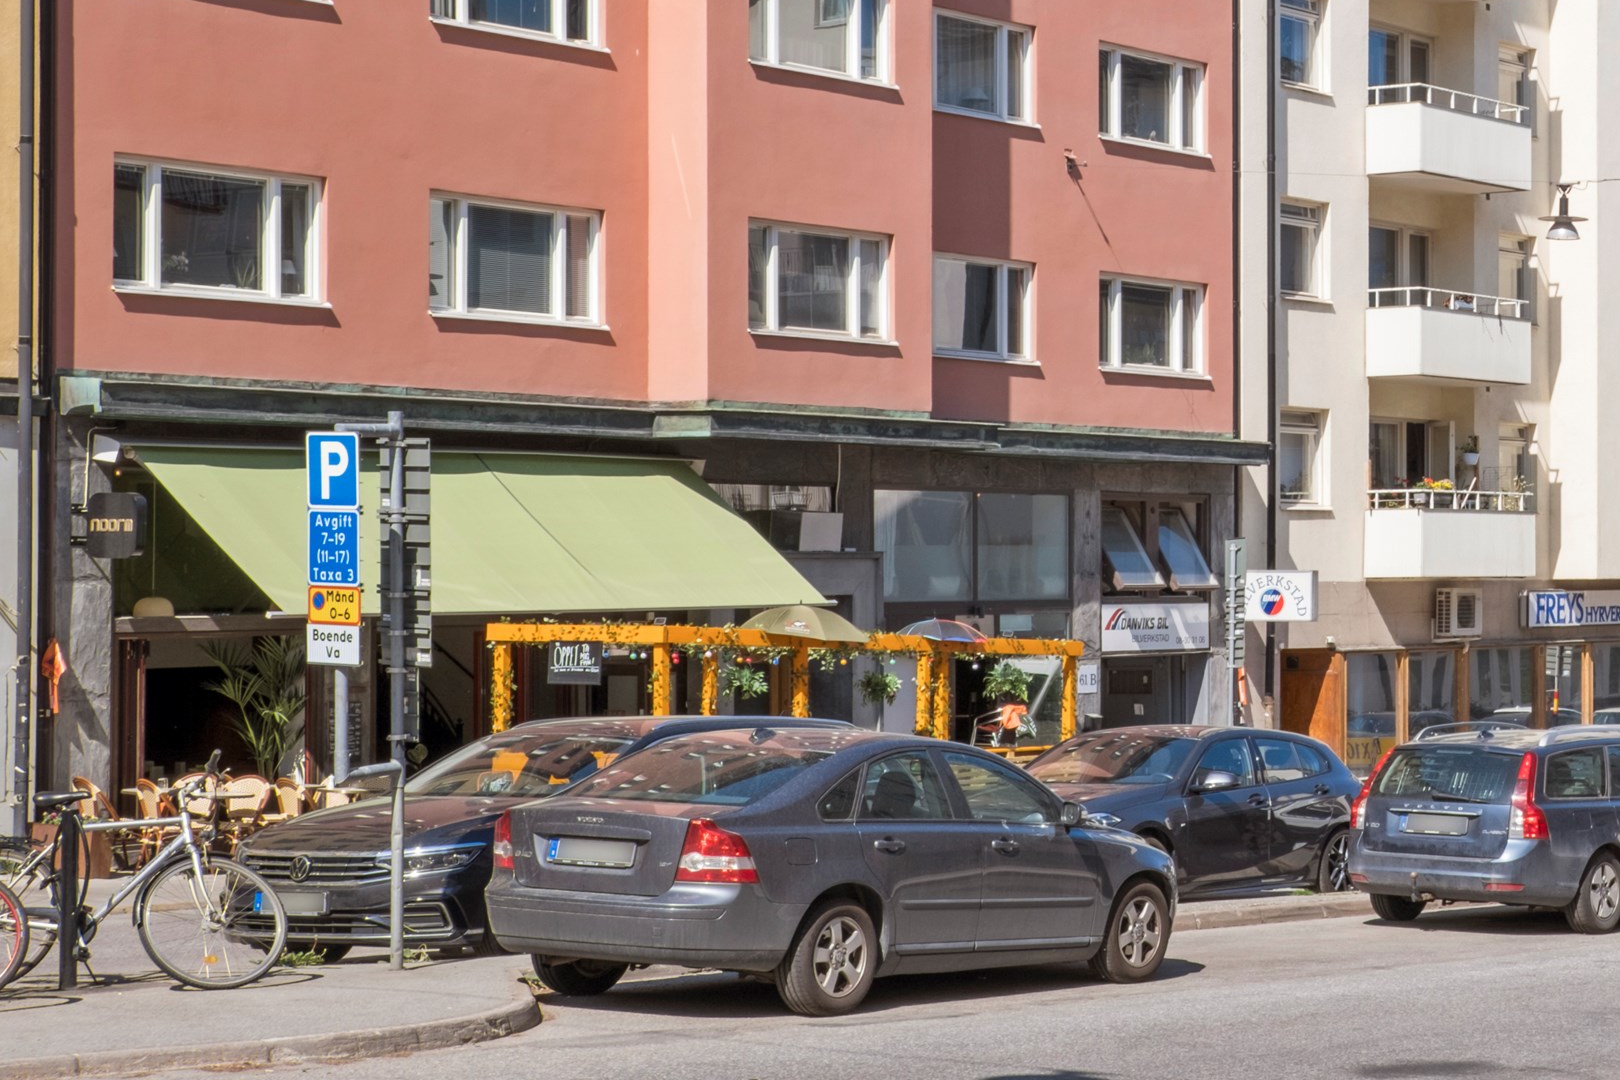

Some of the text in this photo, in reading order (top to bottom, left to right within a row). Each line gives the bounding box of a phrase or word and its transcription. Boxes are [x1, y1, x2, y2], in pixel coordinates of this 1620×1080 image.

[320, 440, 349, 500] P
[315, 514, 352, 530] Avgift
[321, 532, 346, 545] 7-19
[316, 549, 350, 565] (11-17)
[313, 568, 354, 582] Taxa 3
[326, 589, 354, 603] Månd
[329, 607, 351, 620] 0-6
[1535, 592, 1585, 624] FREYS
[1121, 617, 1169, 630] DANVIKS BIL
[312, 629, 353, 643] Boende
[1132, 634, 1170, 643] BILVERKSTAD
[325, 646, 340, 658] Va
[1080, 673, 1097, 686] 61 B
[1403, 802, 1464, 811] VOLVO
